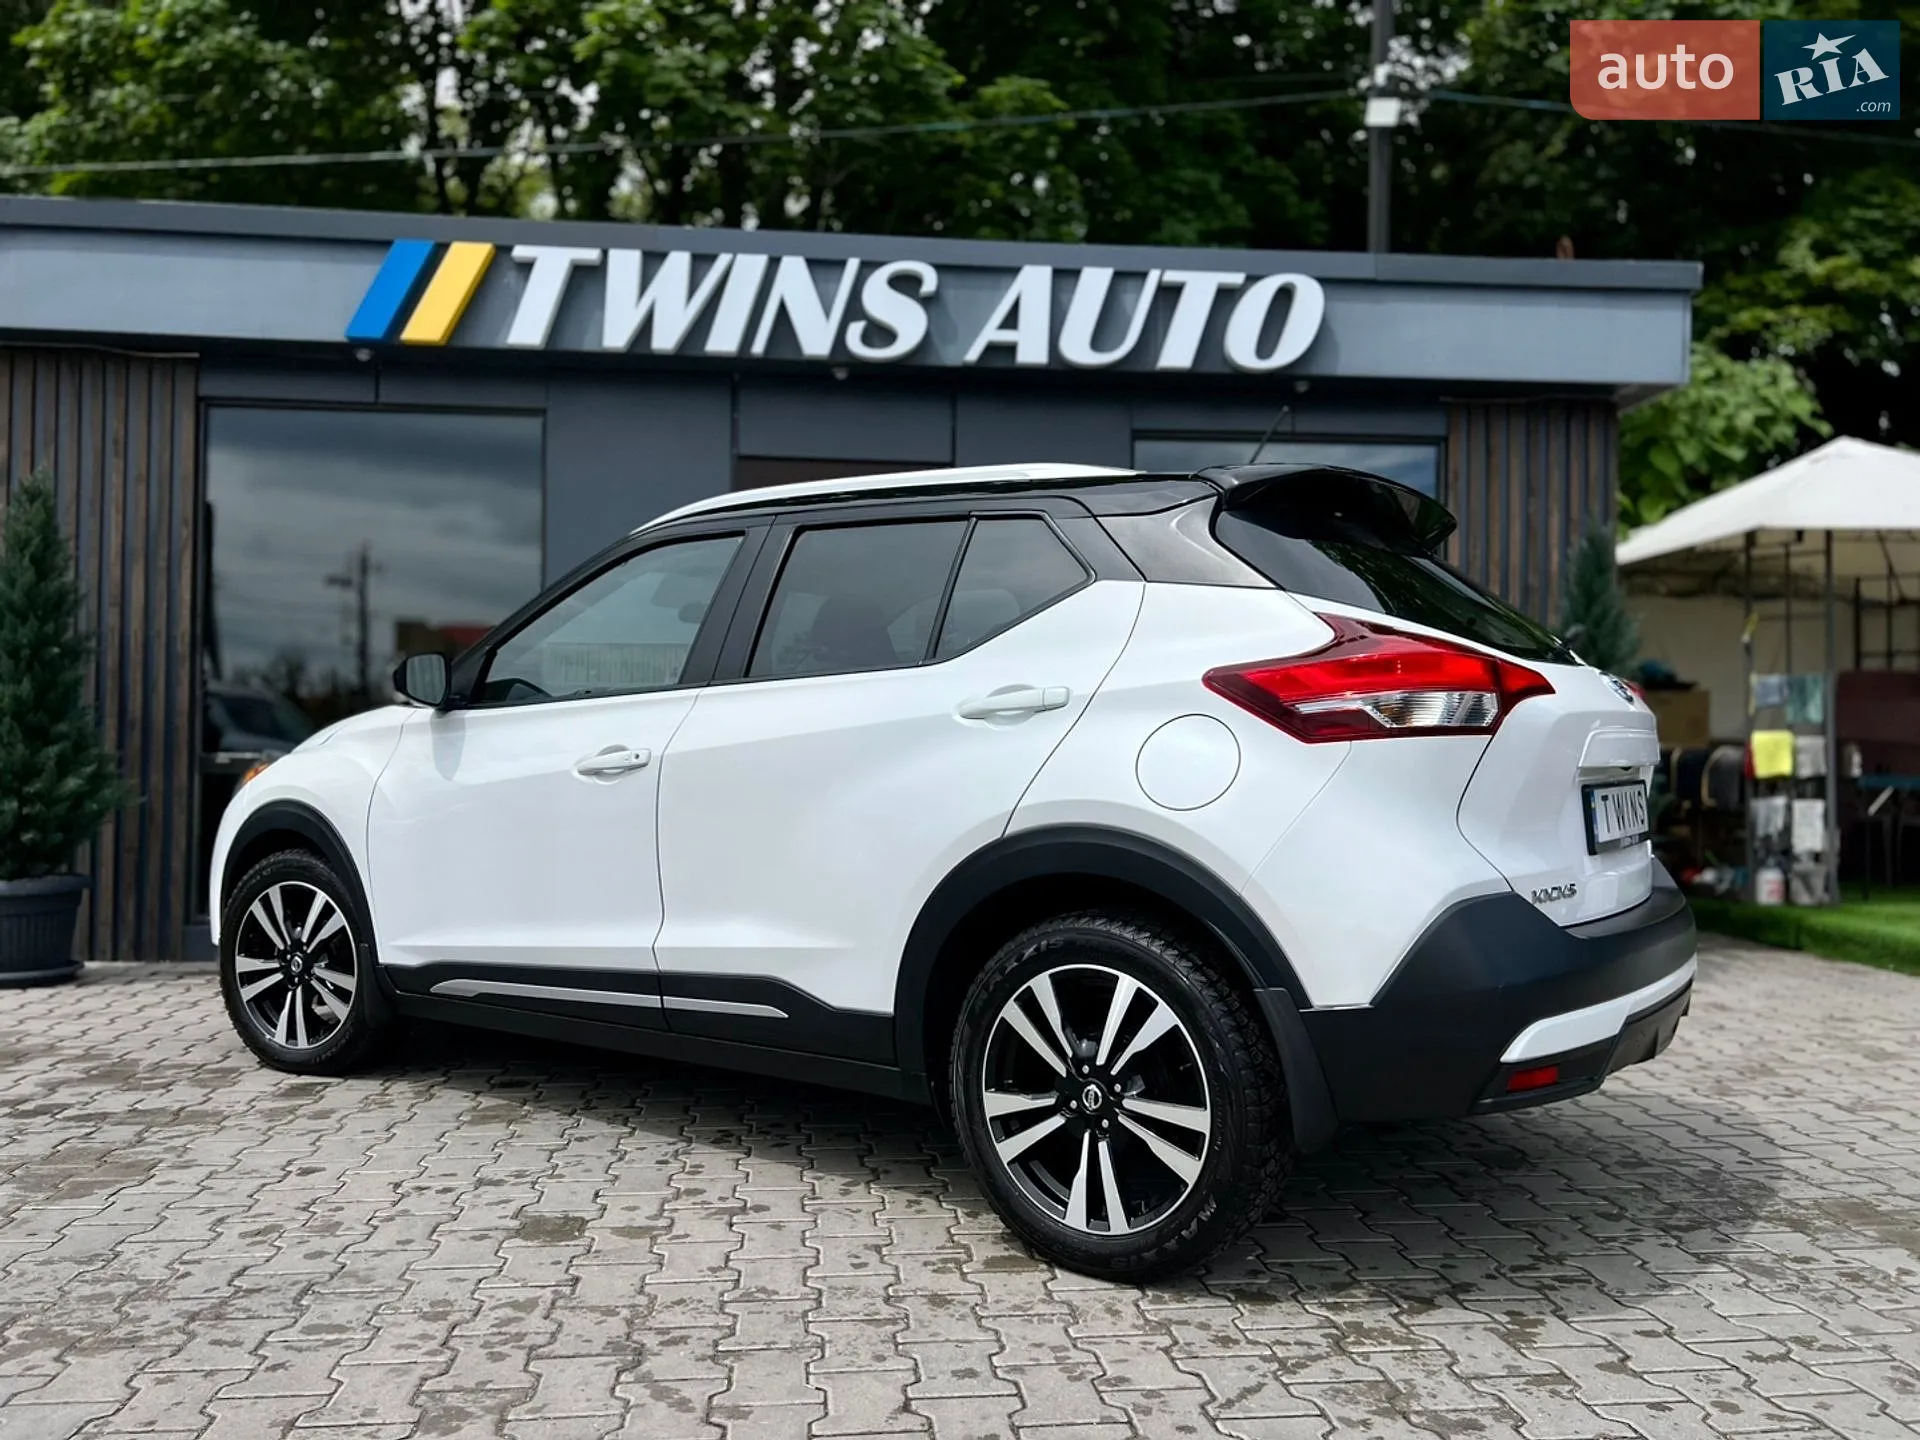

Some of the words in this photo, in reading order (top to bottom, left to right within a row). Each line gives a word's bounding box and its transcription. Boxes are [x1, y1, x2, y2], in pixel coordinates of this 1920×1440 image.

[506, 244, 939, 362] TWINS
[963, 264, 1326, 373] AUTO
[1601, 790, 1645, 833] TWINS
[1531, 883, 1577, 904] KICKS
